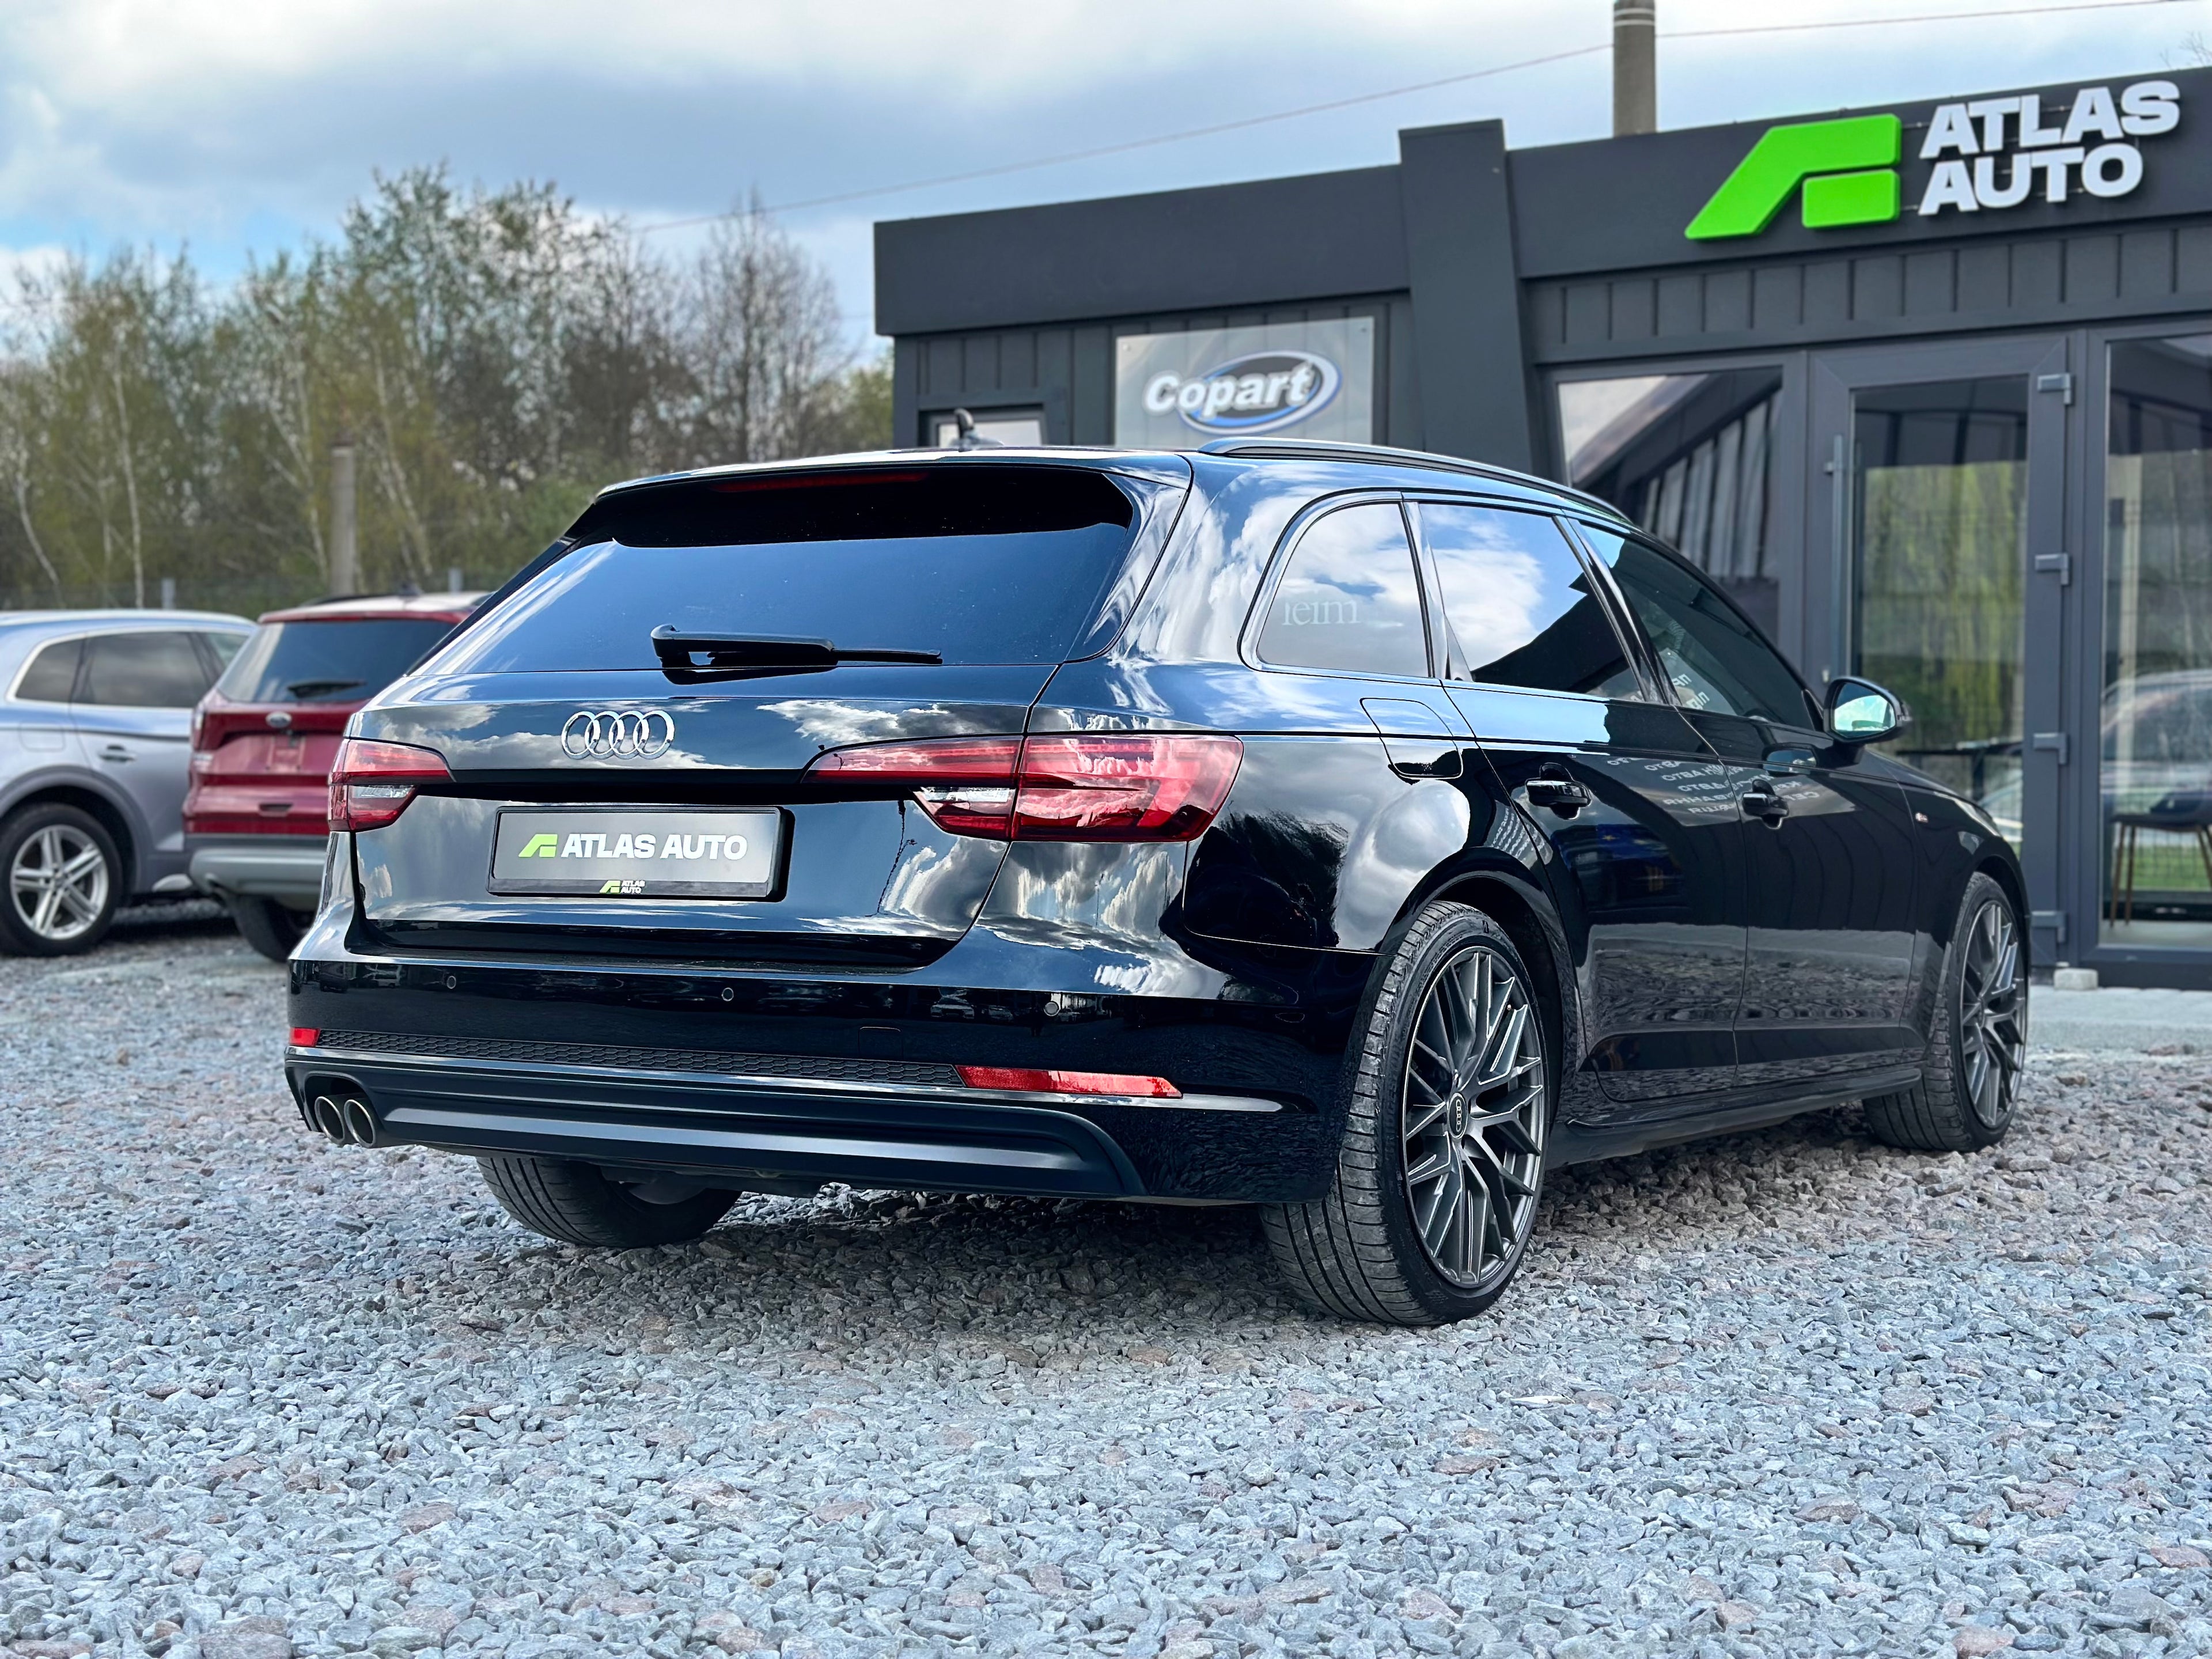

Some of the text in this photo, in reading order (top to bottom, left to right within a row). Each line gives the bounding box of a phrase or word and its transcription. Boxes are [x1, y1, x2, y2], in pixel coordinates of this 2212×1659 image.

[1919, 79, 2181, 159] ATLAS
[1918, 142, 2143, 216] AUTO
[1144, 361, 1315, 421] Copart
[560, 833, 748, 860] ATLAS AUTO
